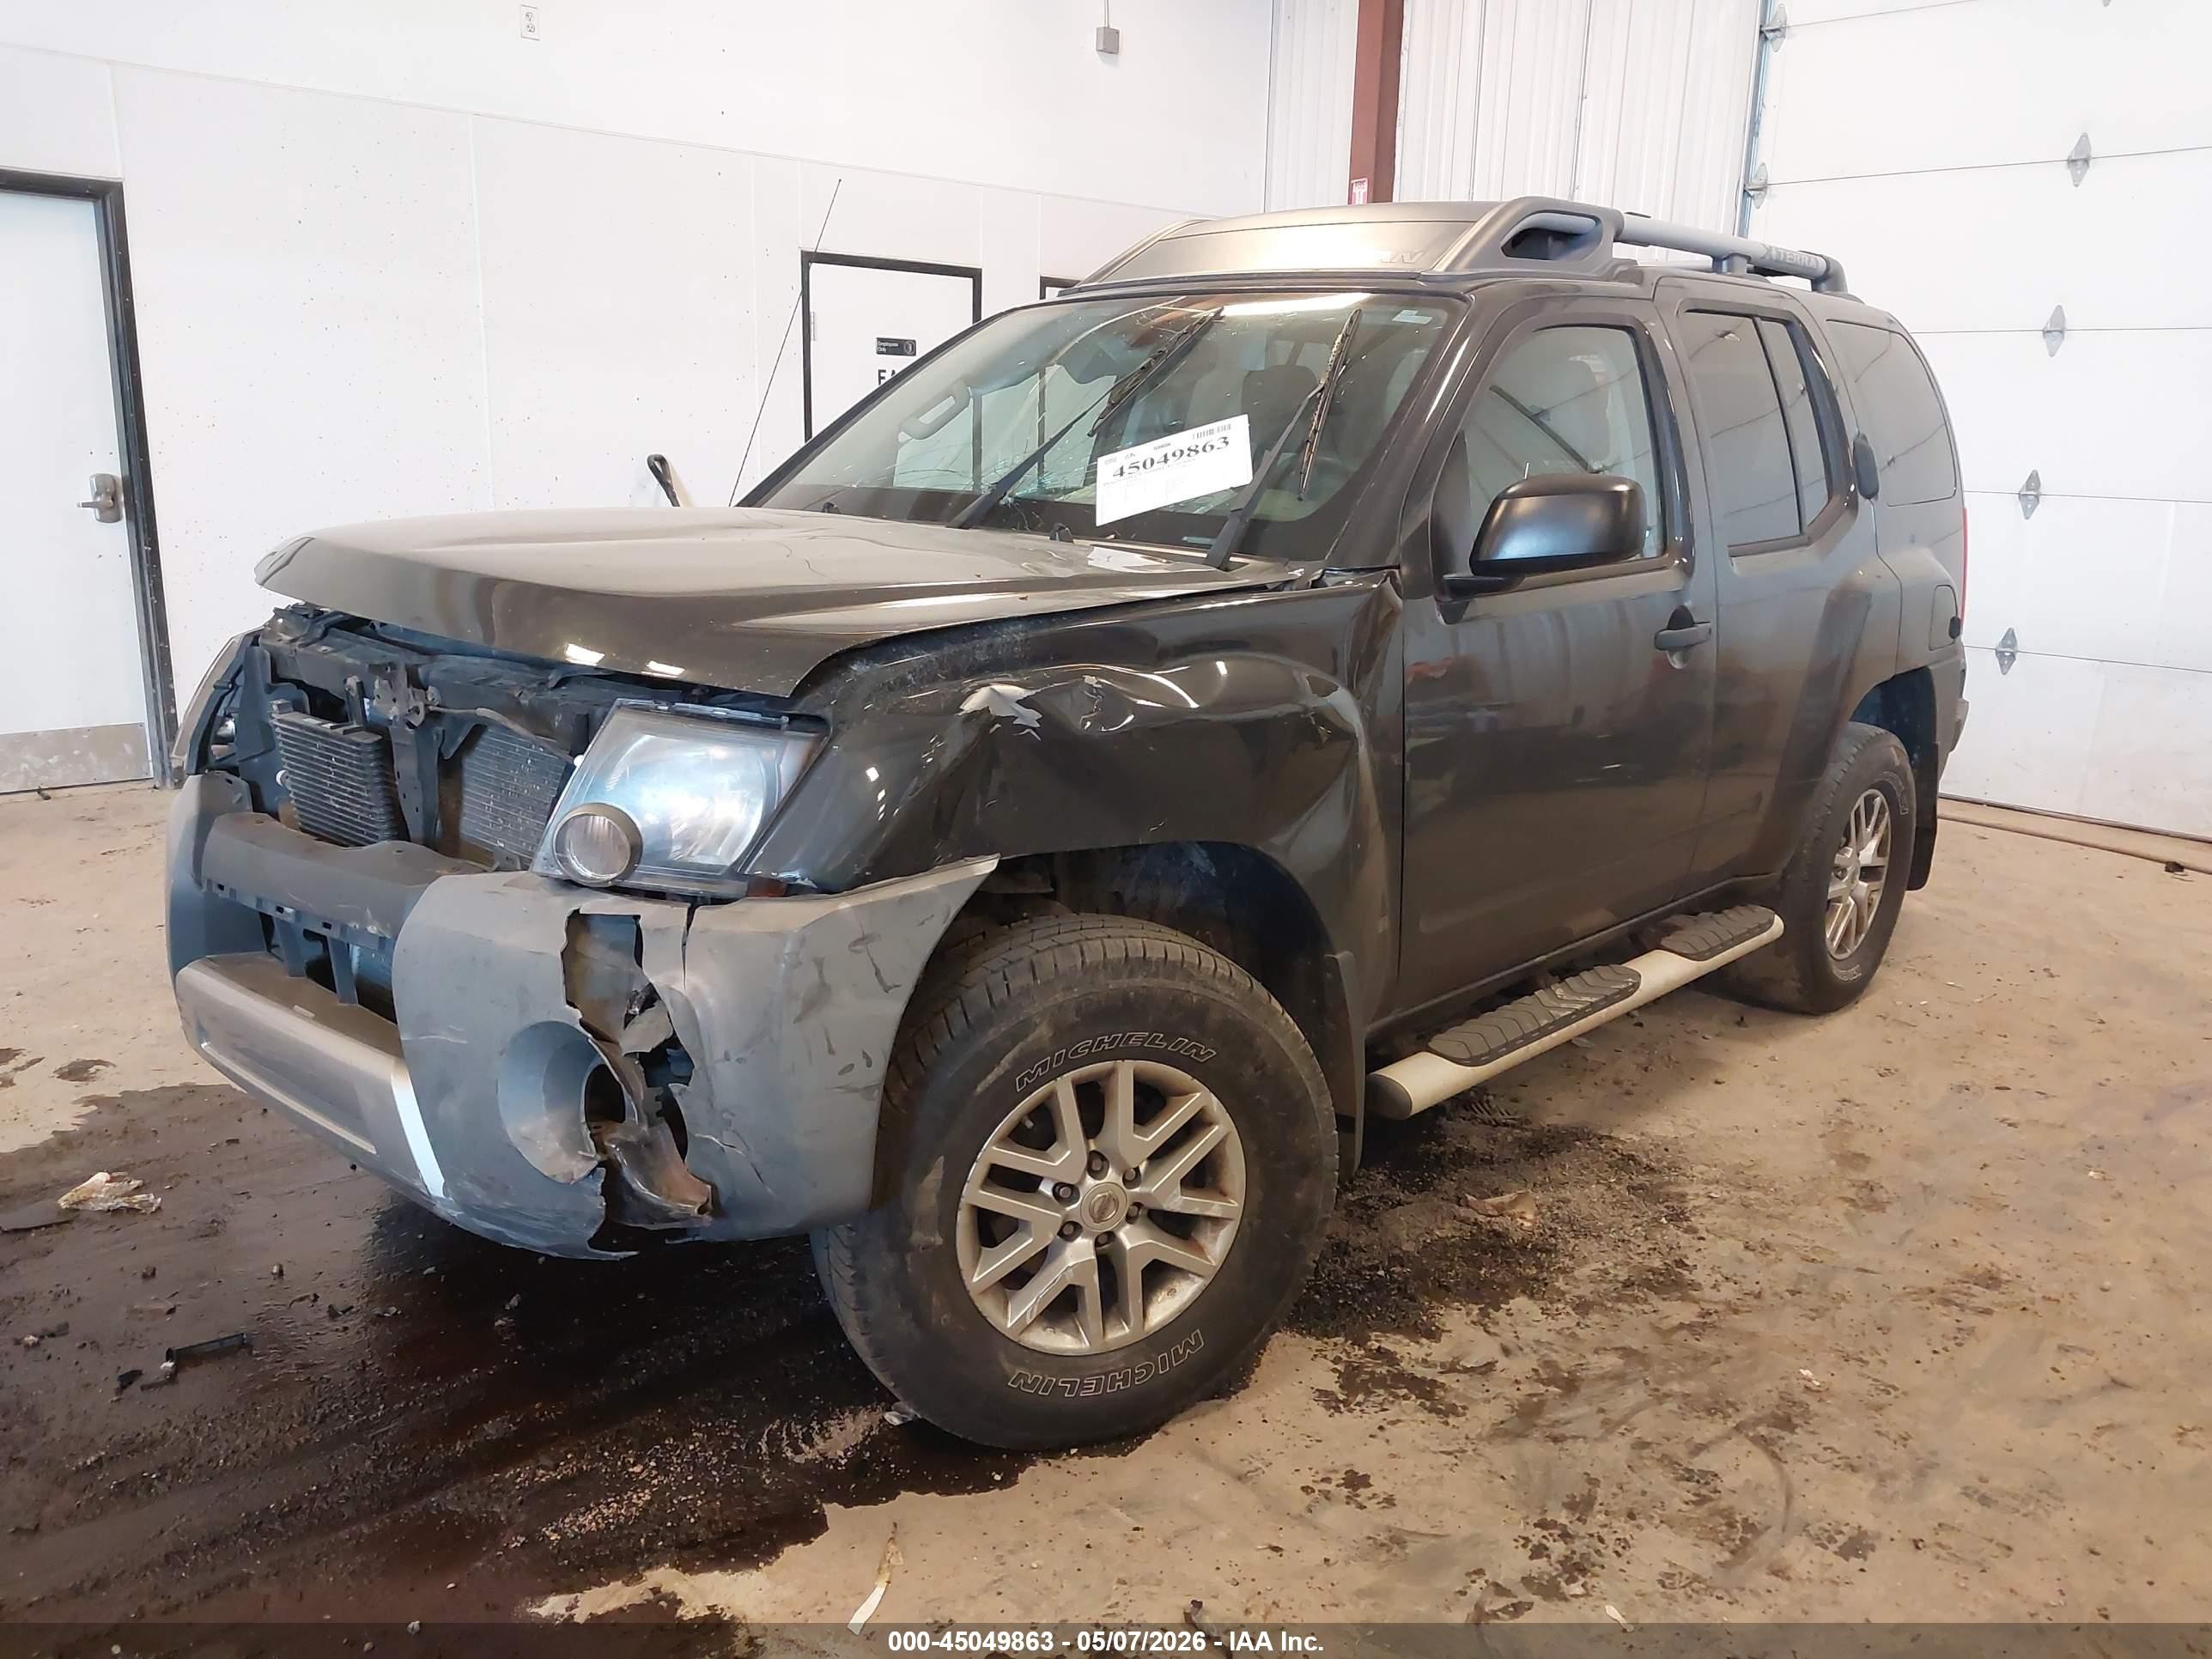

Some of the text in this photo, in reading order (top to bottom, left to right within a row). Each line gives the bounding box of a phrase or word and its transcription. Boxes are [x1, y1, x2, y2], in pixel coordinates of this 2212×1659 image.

[1113, 436, 1230, 477] 45049863
[1016, 1032, 1216, 1091] MICHELIN
[1008, 1329, 1205, 1397] MICHELIN
